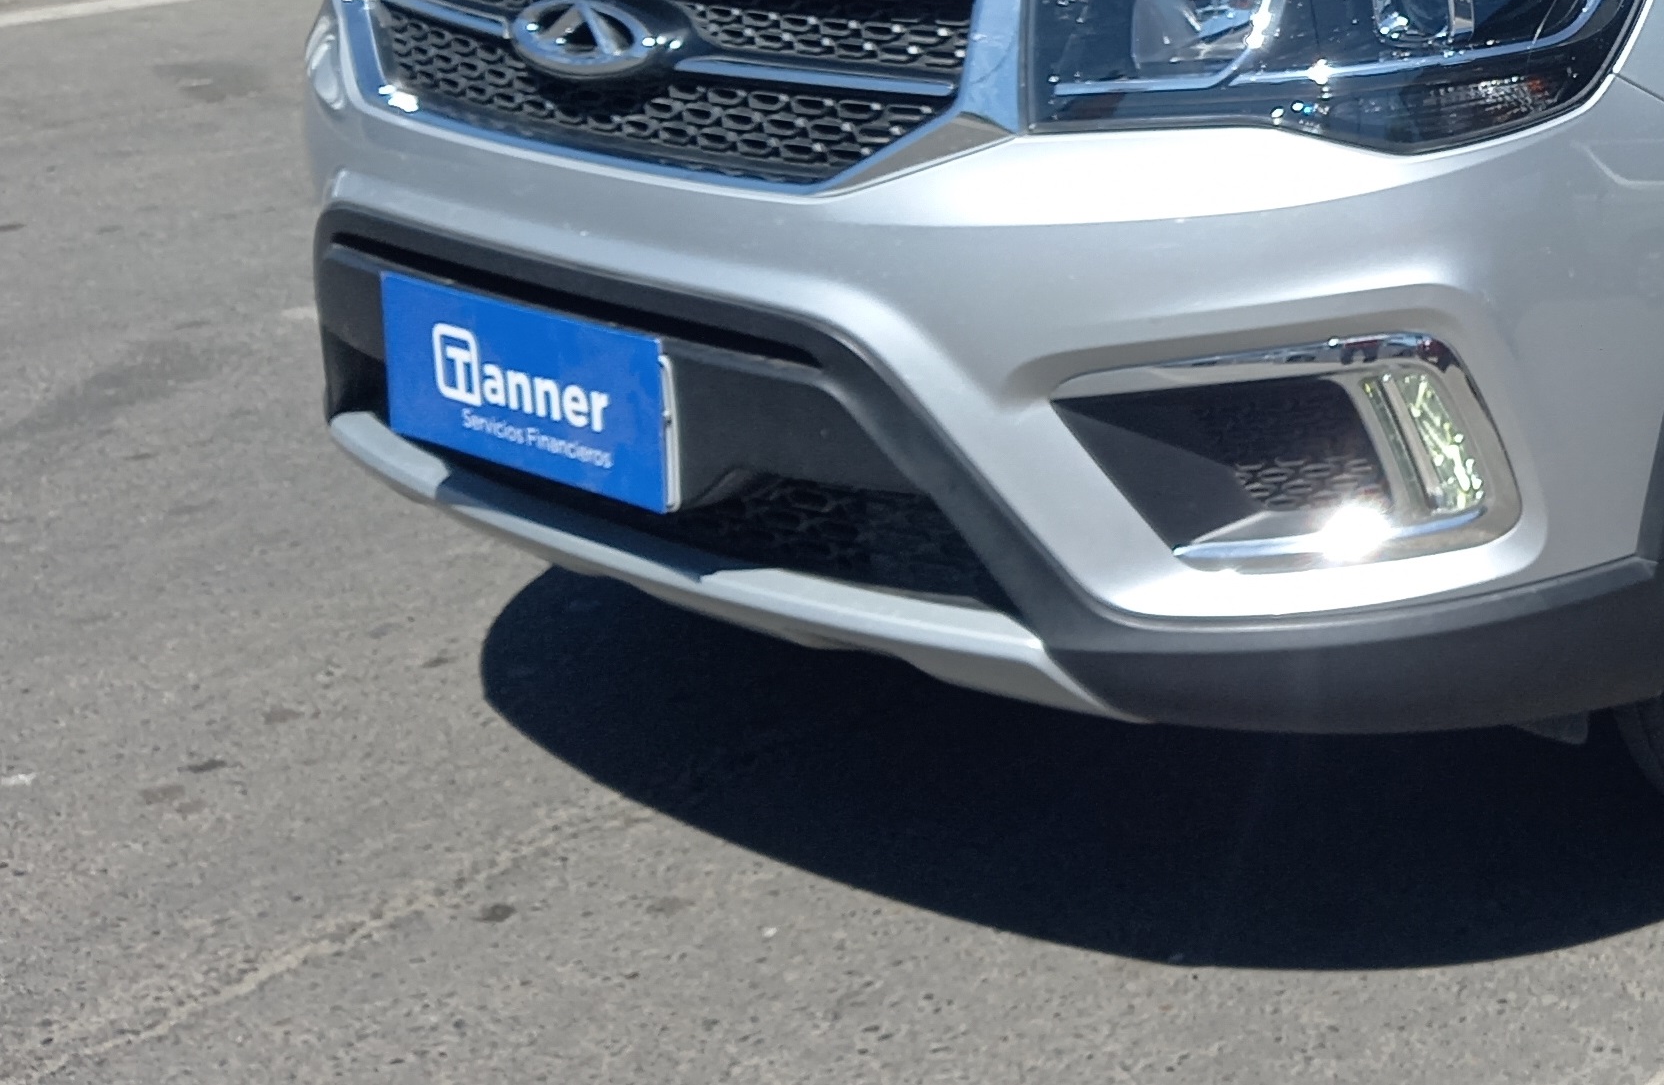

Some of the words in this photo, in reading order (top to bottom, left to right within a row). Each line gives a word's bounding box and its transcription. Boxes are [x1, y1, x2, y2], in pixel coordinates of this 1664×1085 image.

[432, 322, 611, 433] Tanner
[461, 407, 524, 445] Servicios
[525, 426, 614, 469] Financieros
